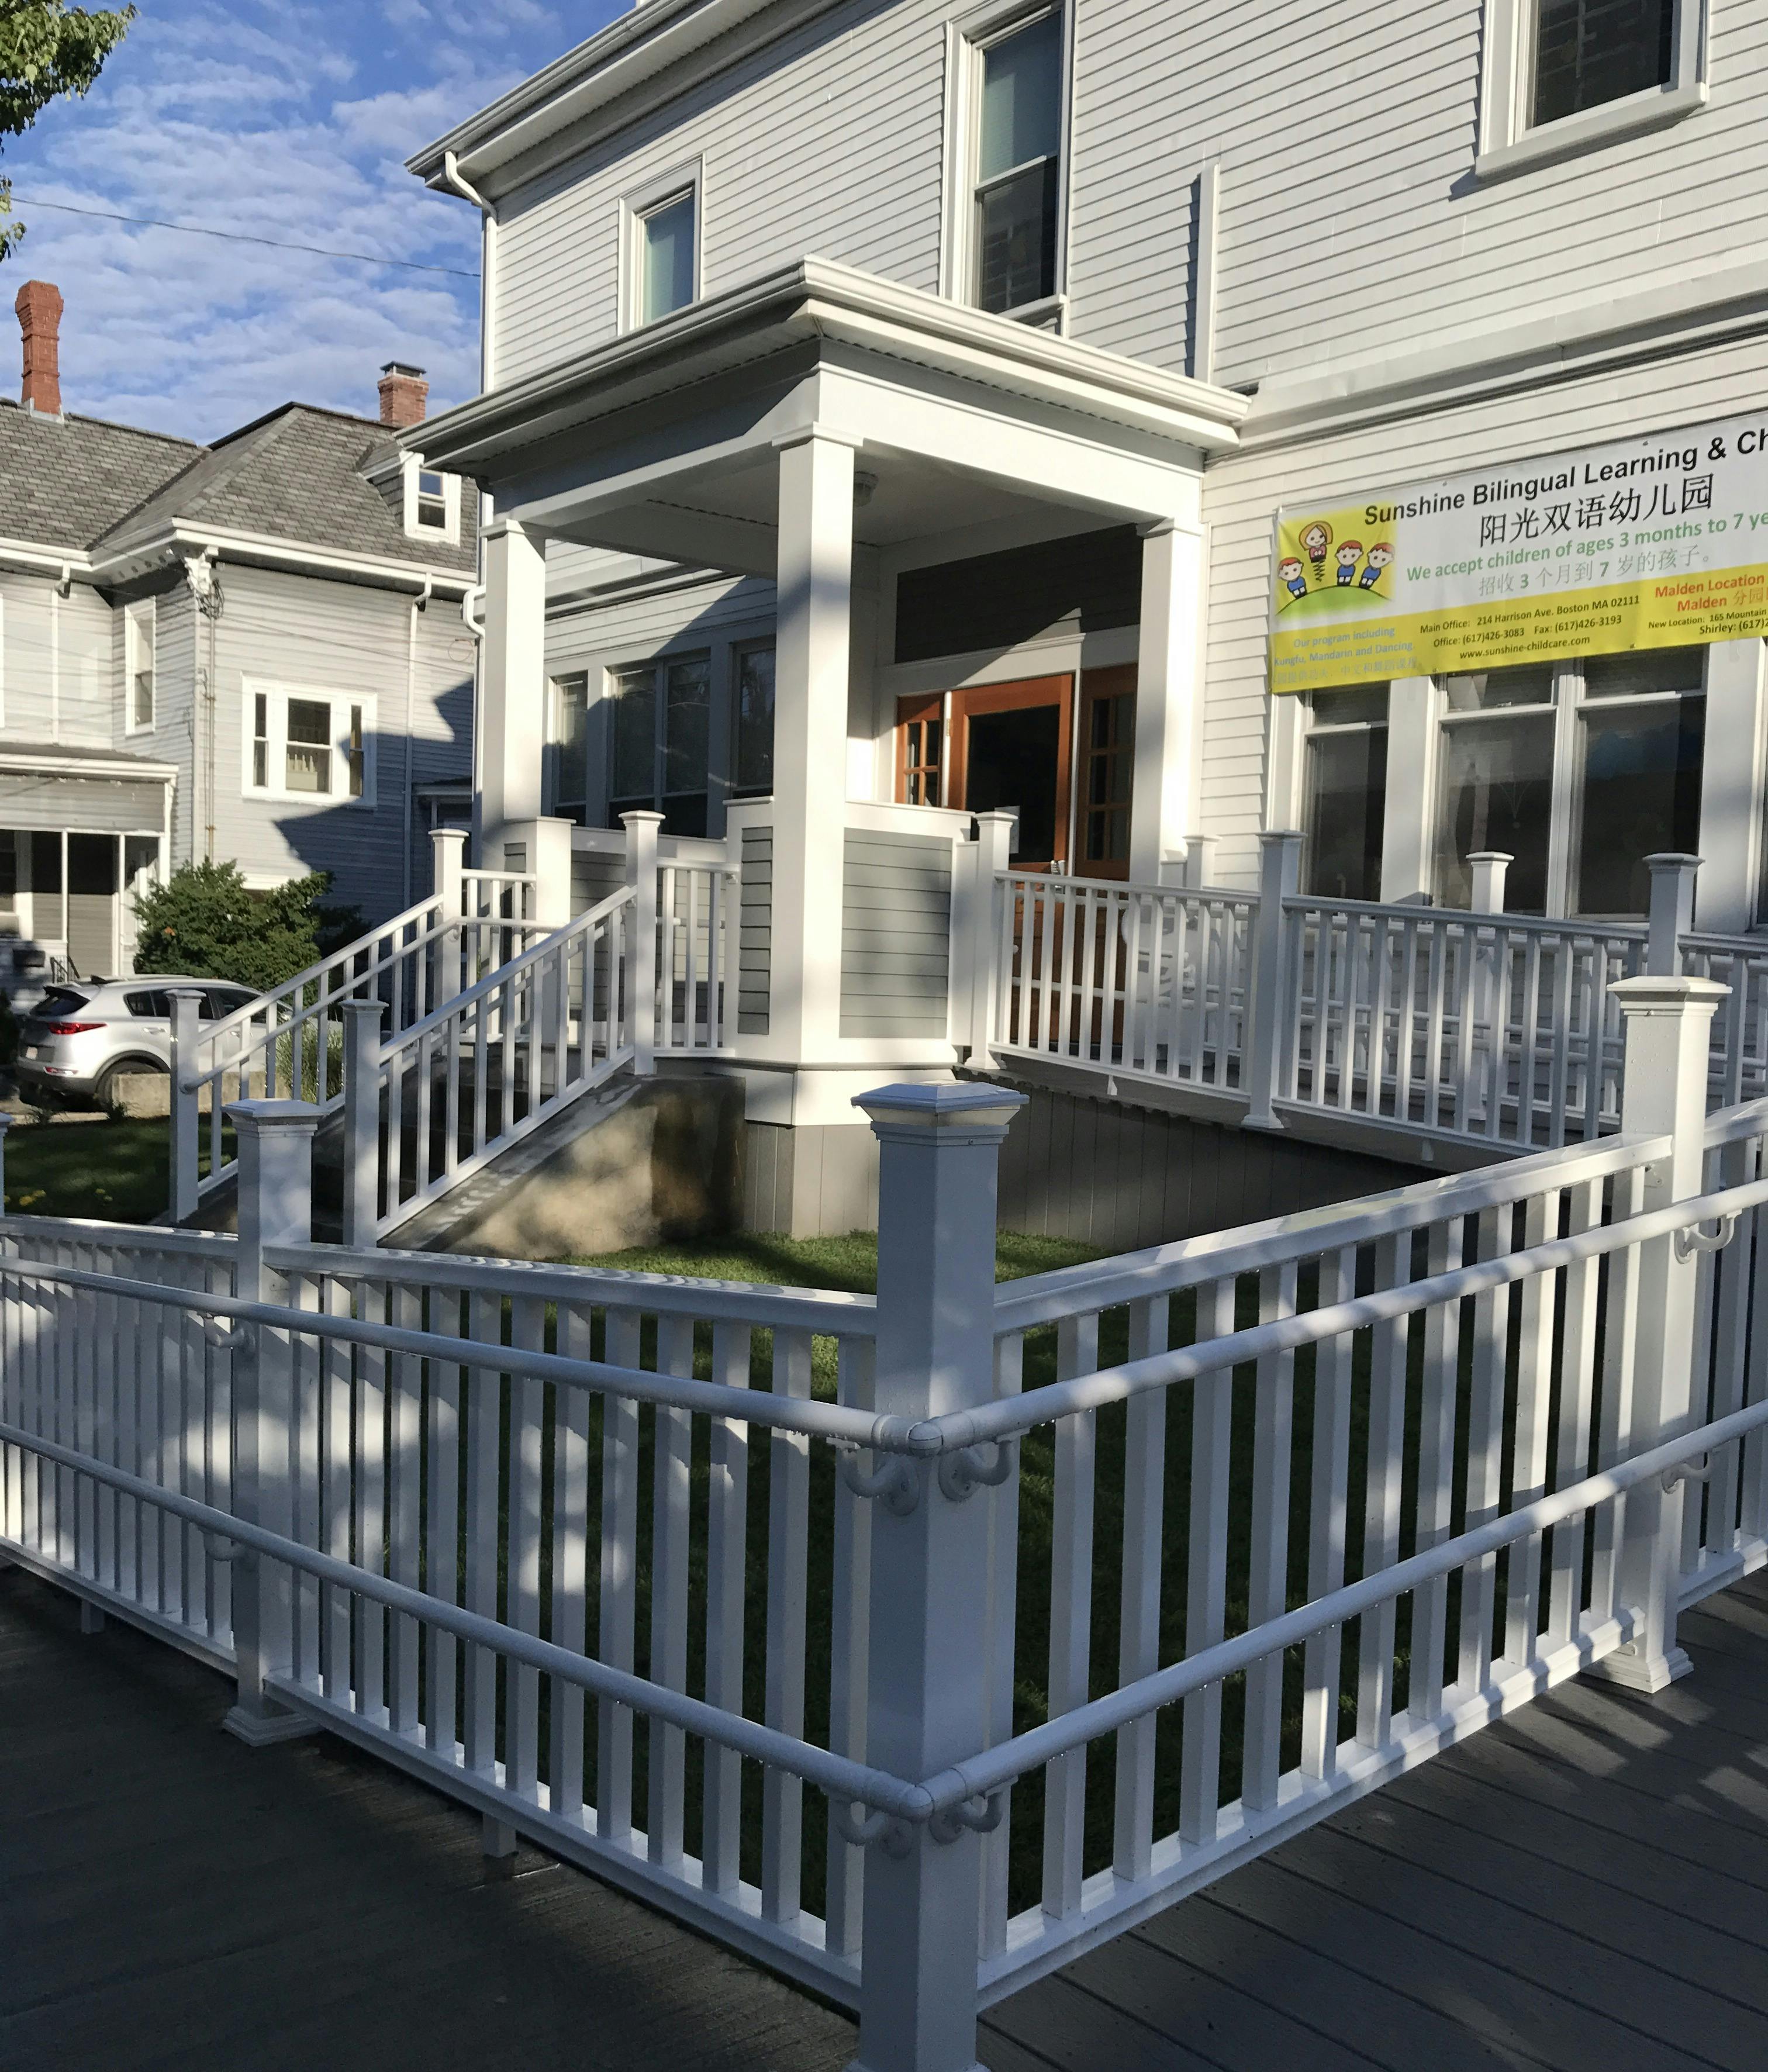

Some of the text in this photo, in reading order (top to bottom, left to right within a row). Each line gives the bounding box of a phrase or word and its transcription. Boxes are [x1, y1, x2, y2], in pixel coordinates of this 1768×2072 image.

[1365, 493, 1465, 525] Sunshine
[1473, 466, 1575, 505] Bilingual
[1584, 447, 1697, 484] Learning
[1708, 437, 1726, 461] &
[1480, 472, 1714, 548] 阳光双语幼儿园
[1407, 566, 1431, 582] We
[1435, 558, 1483, 577] accept
[1487, 546, 1550, 569] children
[1556, 540, 1573, 558] of
[1576, 536, 1614, 556] ages
[1619, 532, 1629, 548] 3
[1635, 522, 1702, 545] months
[1708, 519, 1726, 534] to
[1734, 513, 1744, 529] 7
[1520, 574, 1529, 589] 3
[1600, 561, 1609, 578] 7
[1655, 574, 1764, 599] Malden Location
[1420, 624, 1440, 634] Main
[1443, 620, 1470, 630] Office:
[1477, 614, 1492, 626] 214
[1494, 610, 1532, 623] Harrison
[1557, 603, 1589, 615] Boston
[1591, 600, 1608, 610] MA
[1611, 595, 1639, 607] 02111
[1677, 596, 1727, 612] Malden
[1669, 616, 1705, 627] Location:
[1710, 613, 1724, 622] 165
[1726, 609, 1767, 620] Mountain
[1699, 622, 1736, 635] Shirley:
[1294, 627, 1395, 648] Our program including
[1434, 615, 1622, 648] Office: (617)426-3083 Fax: (617)426-3193
[1310, 649, 1352, 661] Mandarin
[1356, 645, 1372, 655] and
[1460, 636, 1590, 659] www.sunshine-childcare.com
